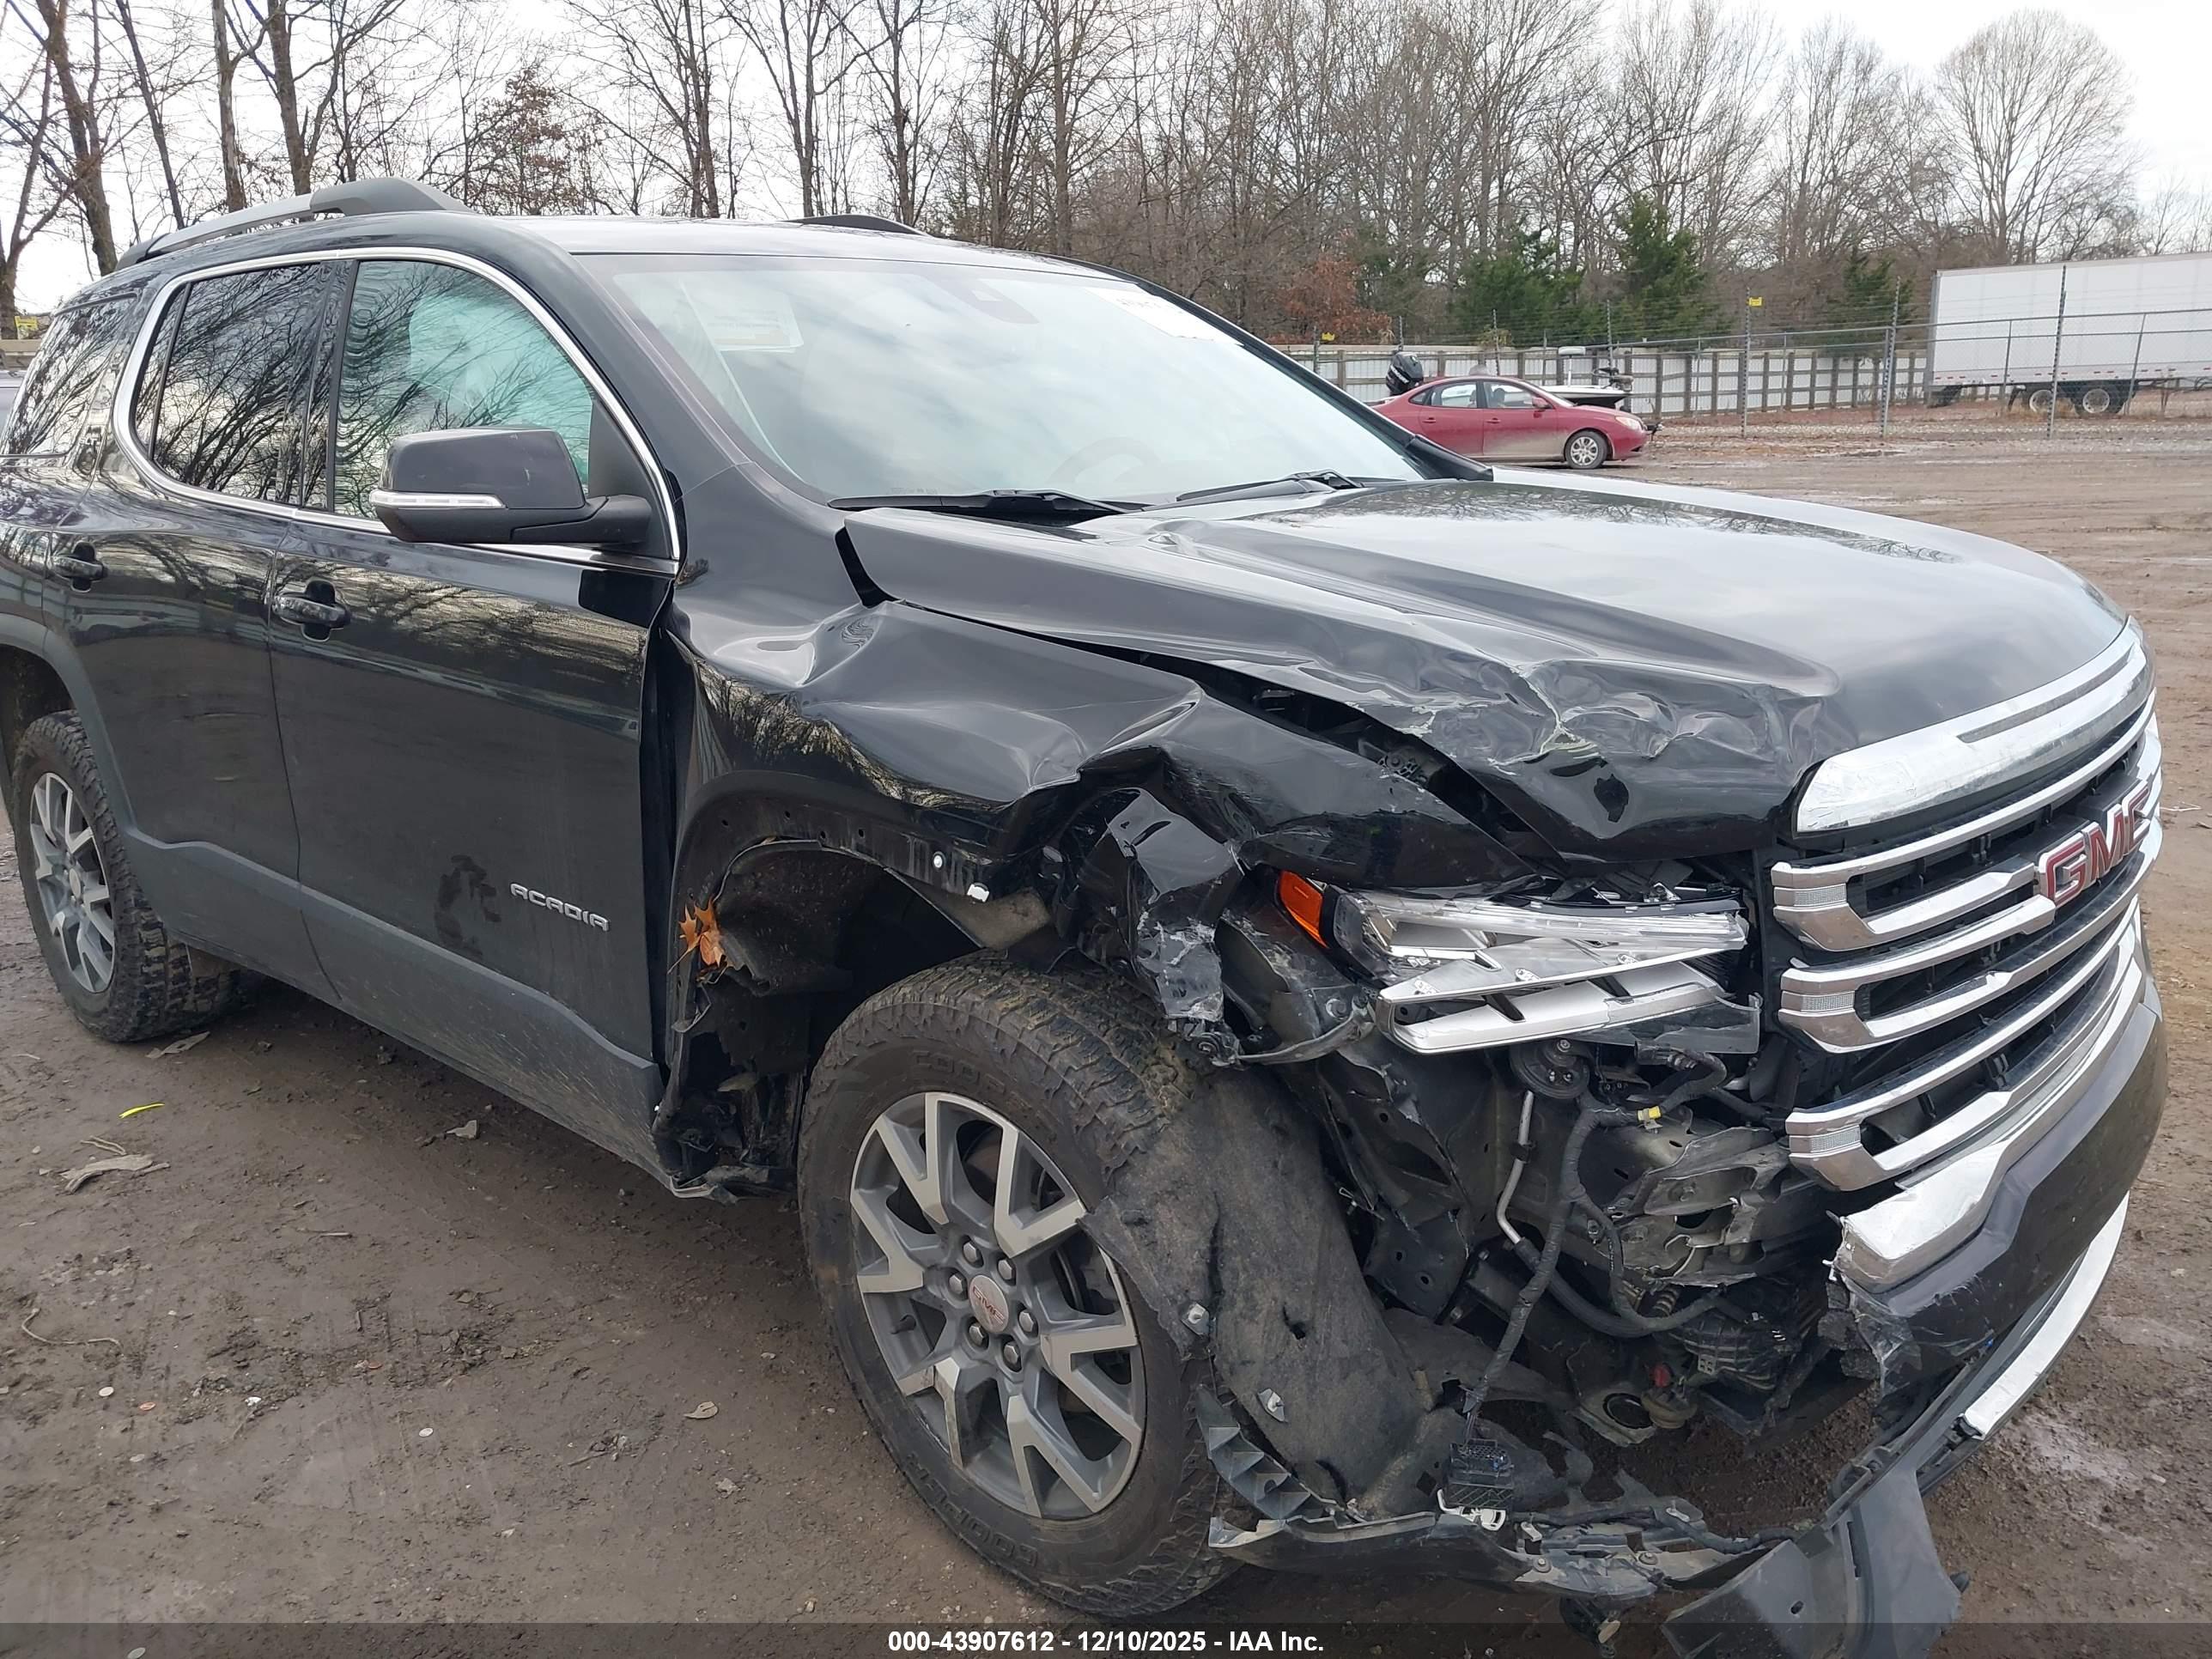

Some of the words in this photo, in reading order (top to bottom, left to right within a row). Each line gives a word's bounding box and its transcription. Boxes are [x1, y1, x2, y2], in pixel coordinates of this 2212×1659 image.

[2038, 779, 2151, 908] GMC
[510, 883, 609, 932] ACADIA
[972, 1285, 1006, 1325] GMC
